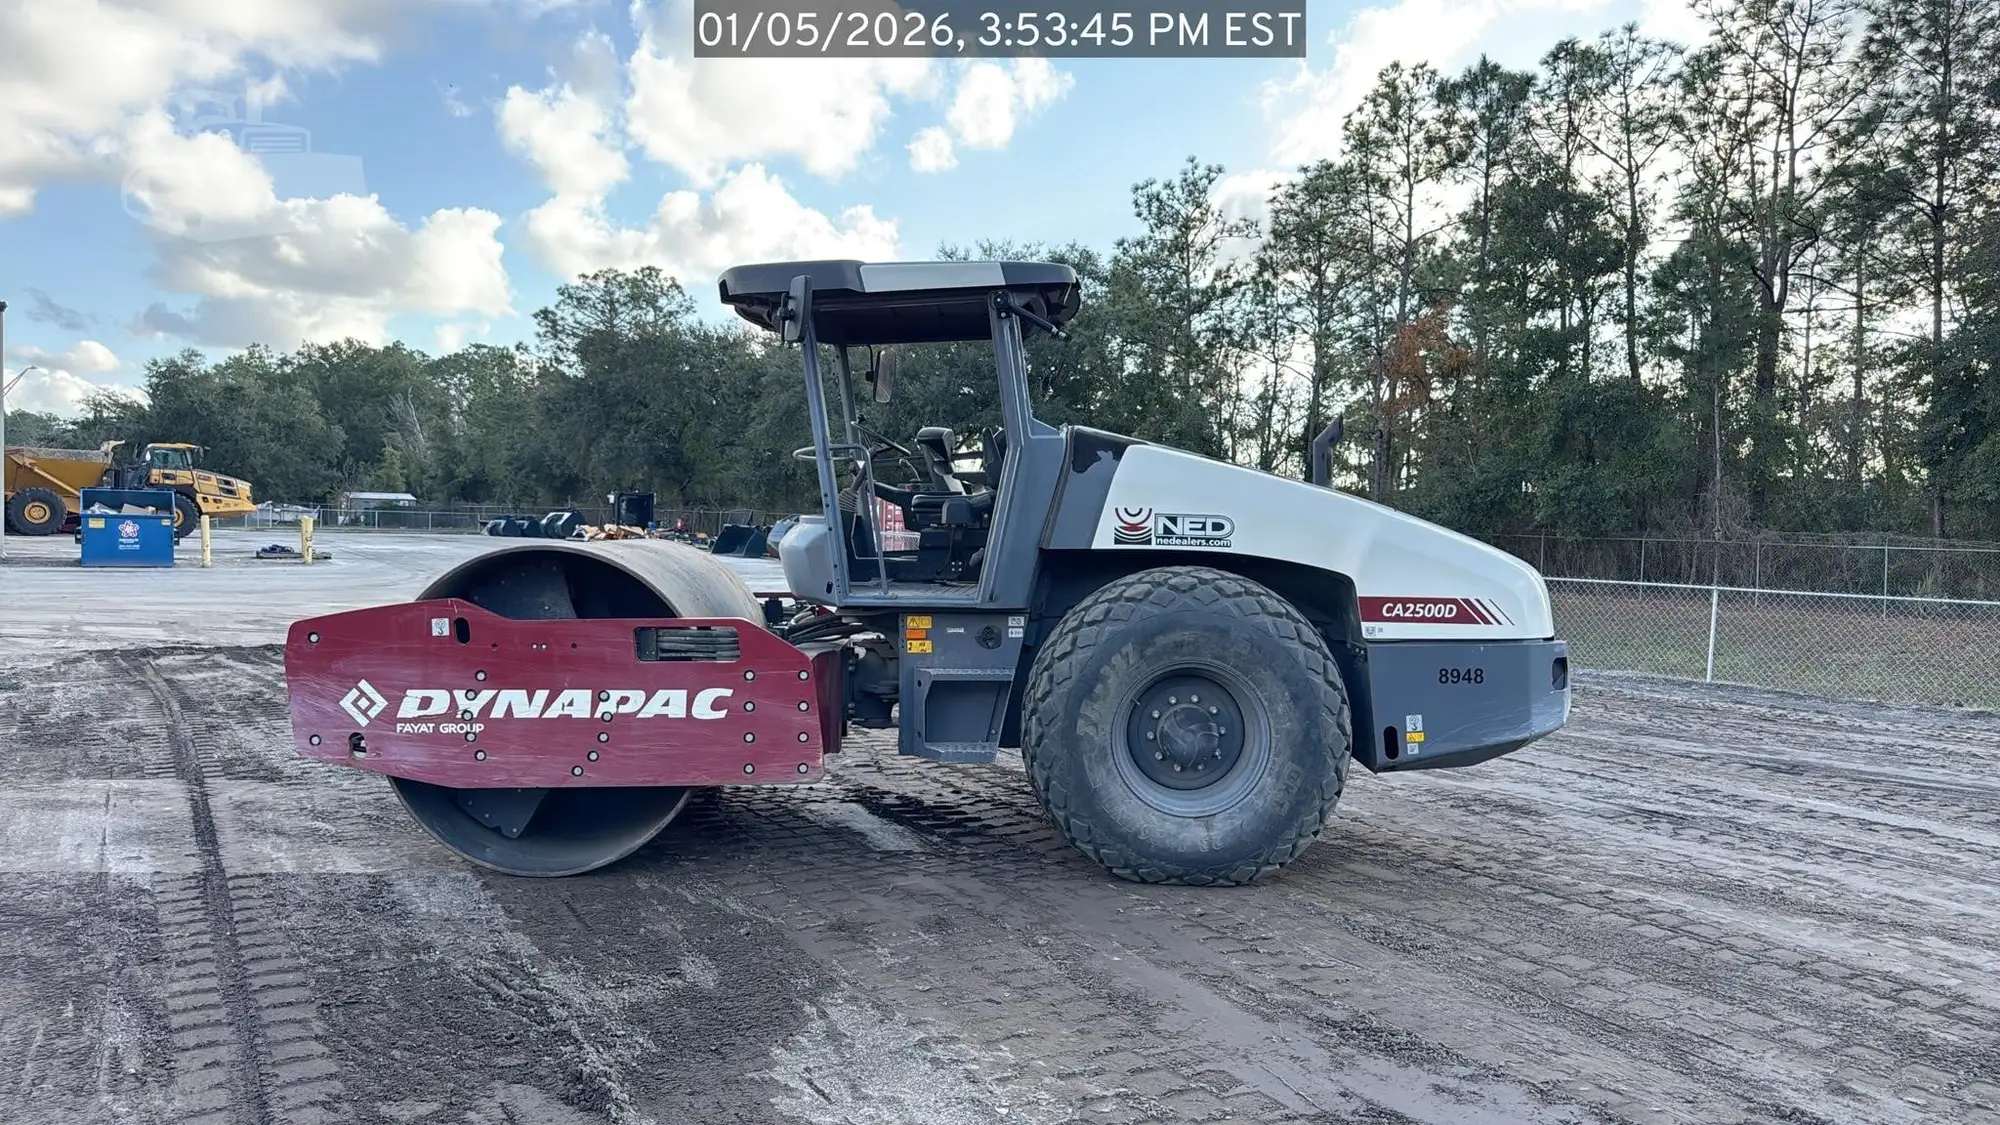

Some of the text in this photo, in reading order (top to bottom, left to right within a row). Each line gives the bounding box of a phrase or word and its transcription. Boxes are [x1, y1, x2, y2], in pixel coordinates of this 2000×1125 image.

[1156, 516, 1233, 536] NED
[1156, 536, 1231, 547] nedealers.com
[1382, 603, 1457, 618] CA2500D
[1438, 667, 1484, 685] 8948
[396, 688, 734, 720] DYNAPAC
[396, 723, 485, 734] FAYAT GROUP
